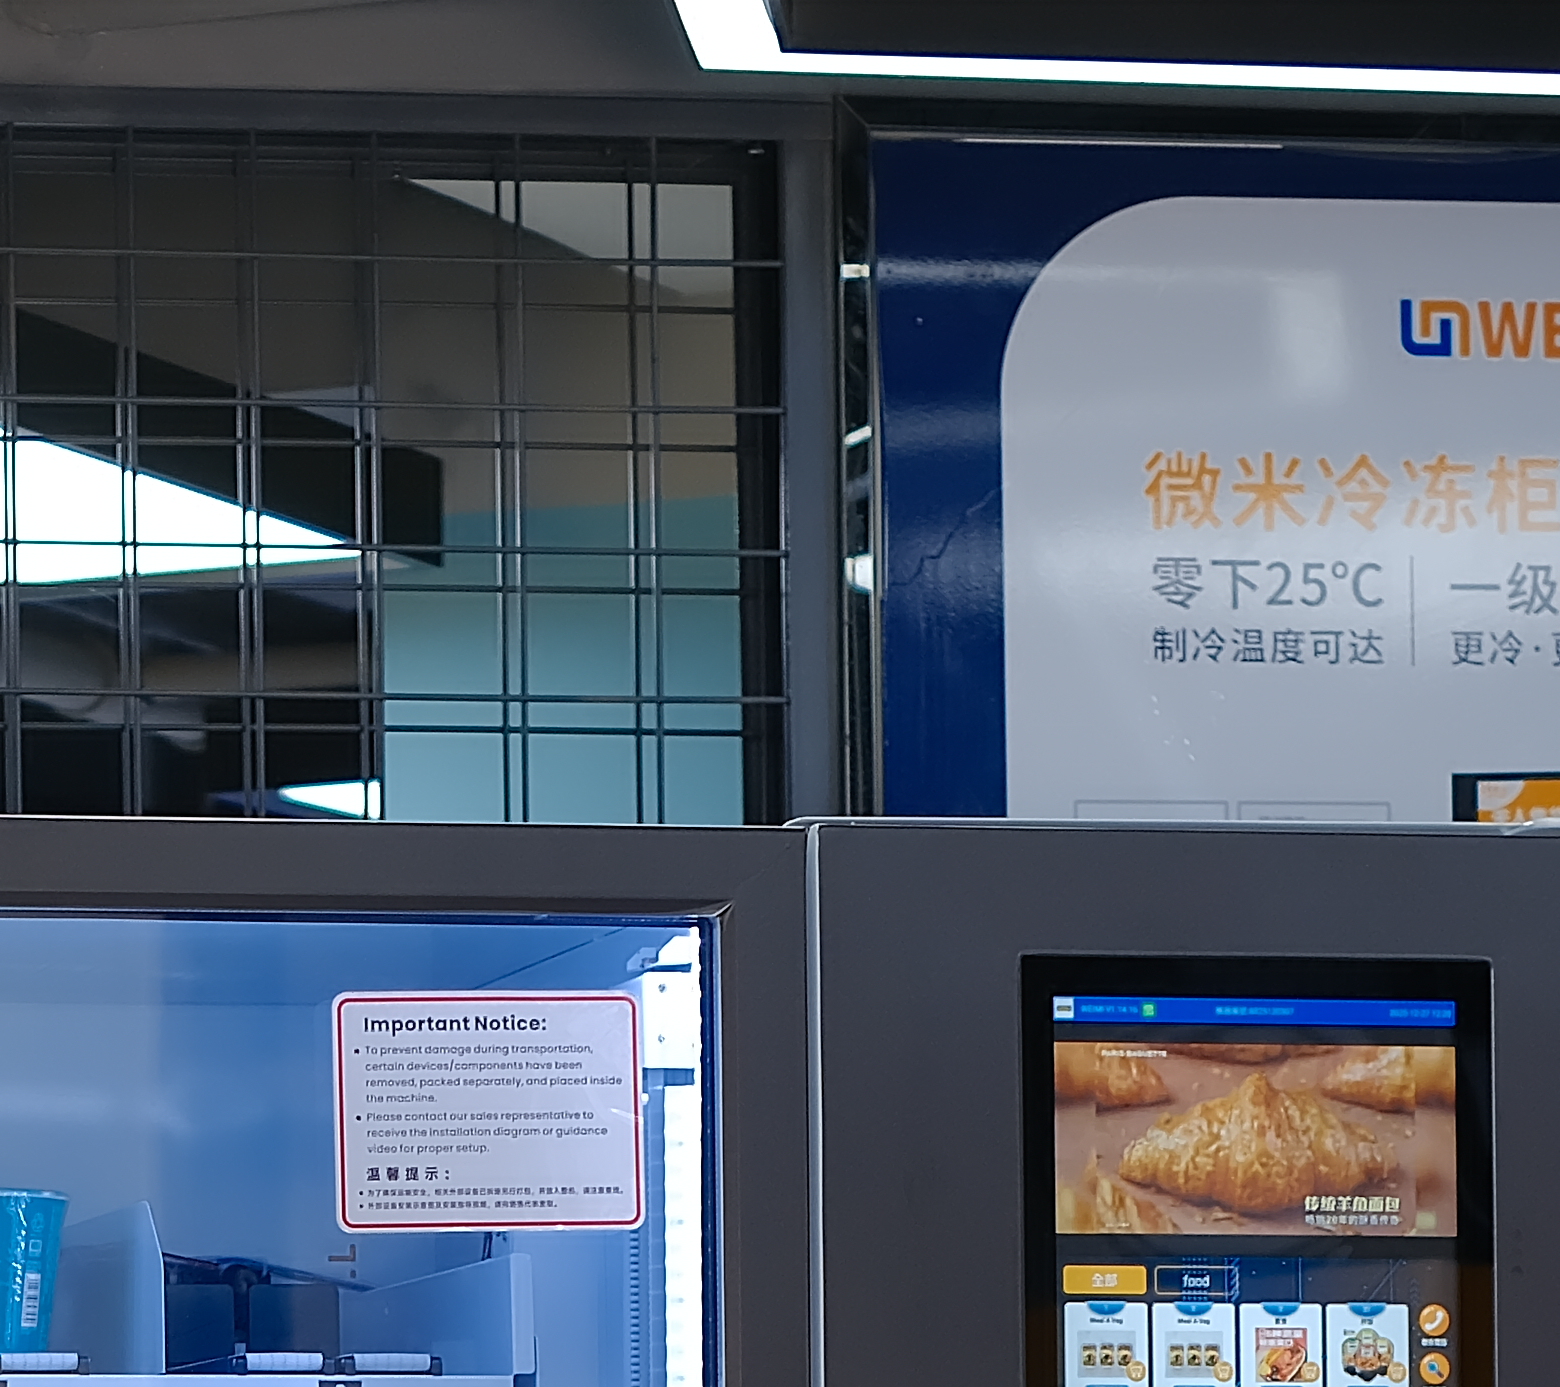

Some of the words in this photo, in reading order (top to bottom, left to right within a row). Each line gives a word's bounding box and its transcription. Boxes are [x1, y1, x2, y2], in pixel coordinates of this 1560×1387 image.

[1152, 627, 1385, 667] 制冷温度可达
[364, 1016, 471, 1038] Important
[474, 1014, 547, 1031] Notice:
[365, 1045, 378, 1055] To
[379, 1045, 423, 1058] prevent
[424, 1045, 472, 1057] damage
[473, 1043, 510, 1057] during
[510, 1044, 594, 1055] transportation,
[1182, 1273, 1211, 1289] food
